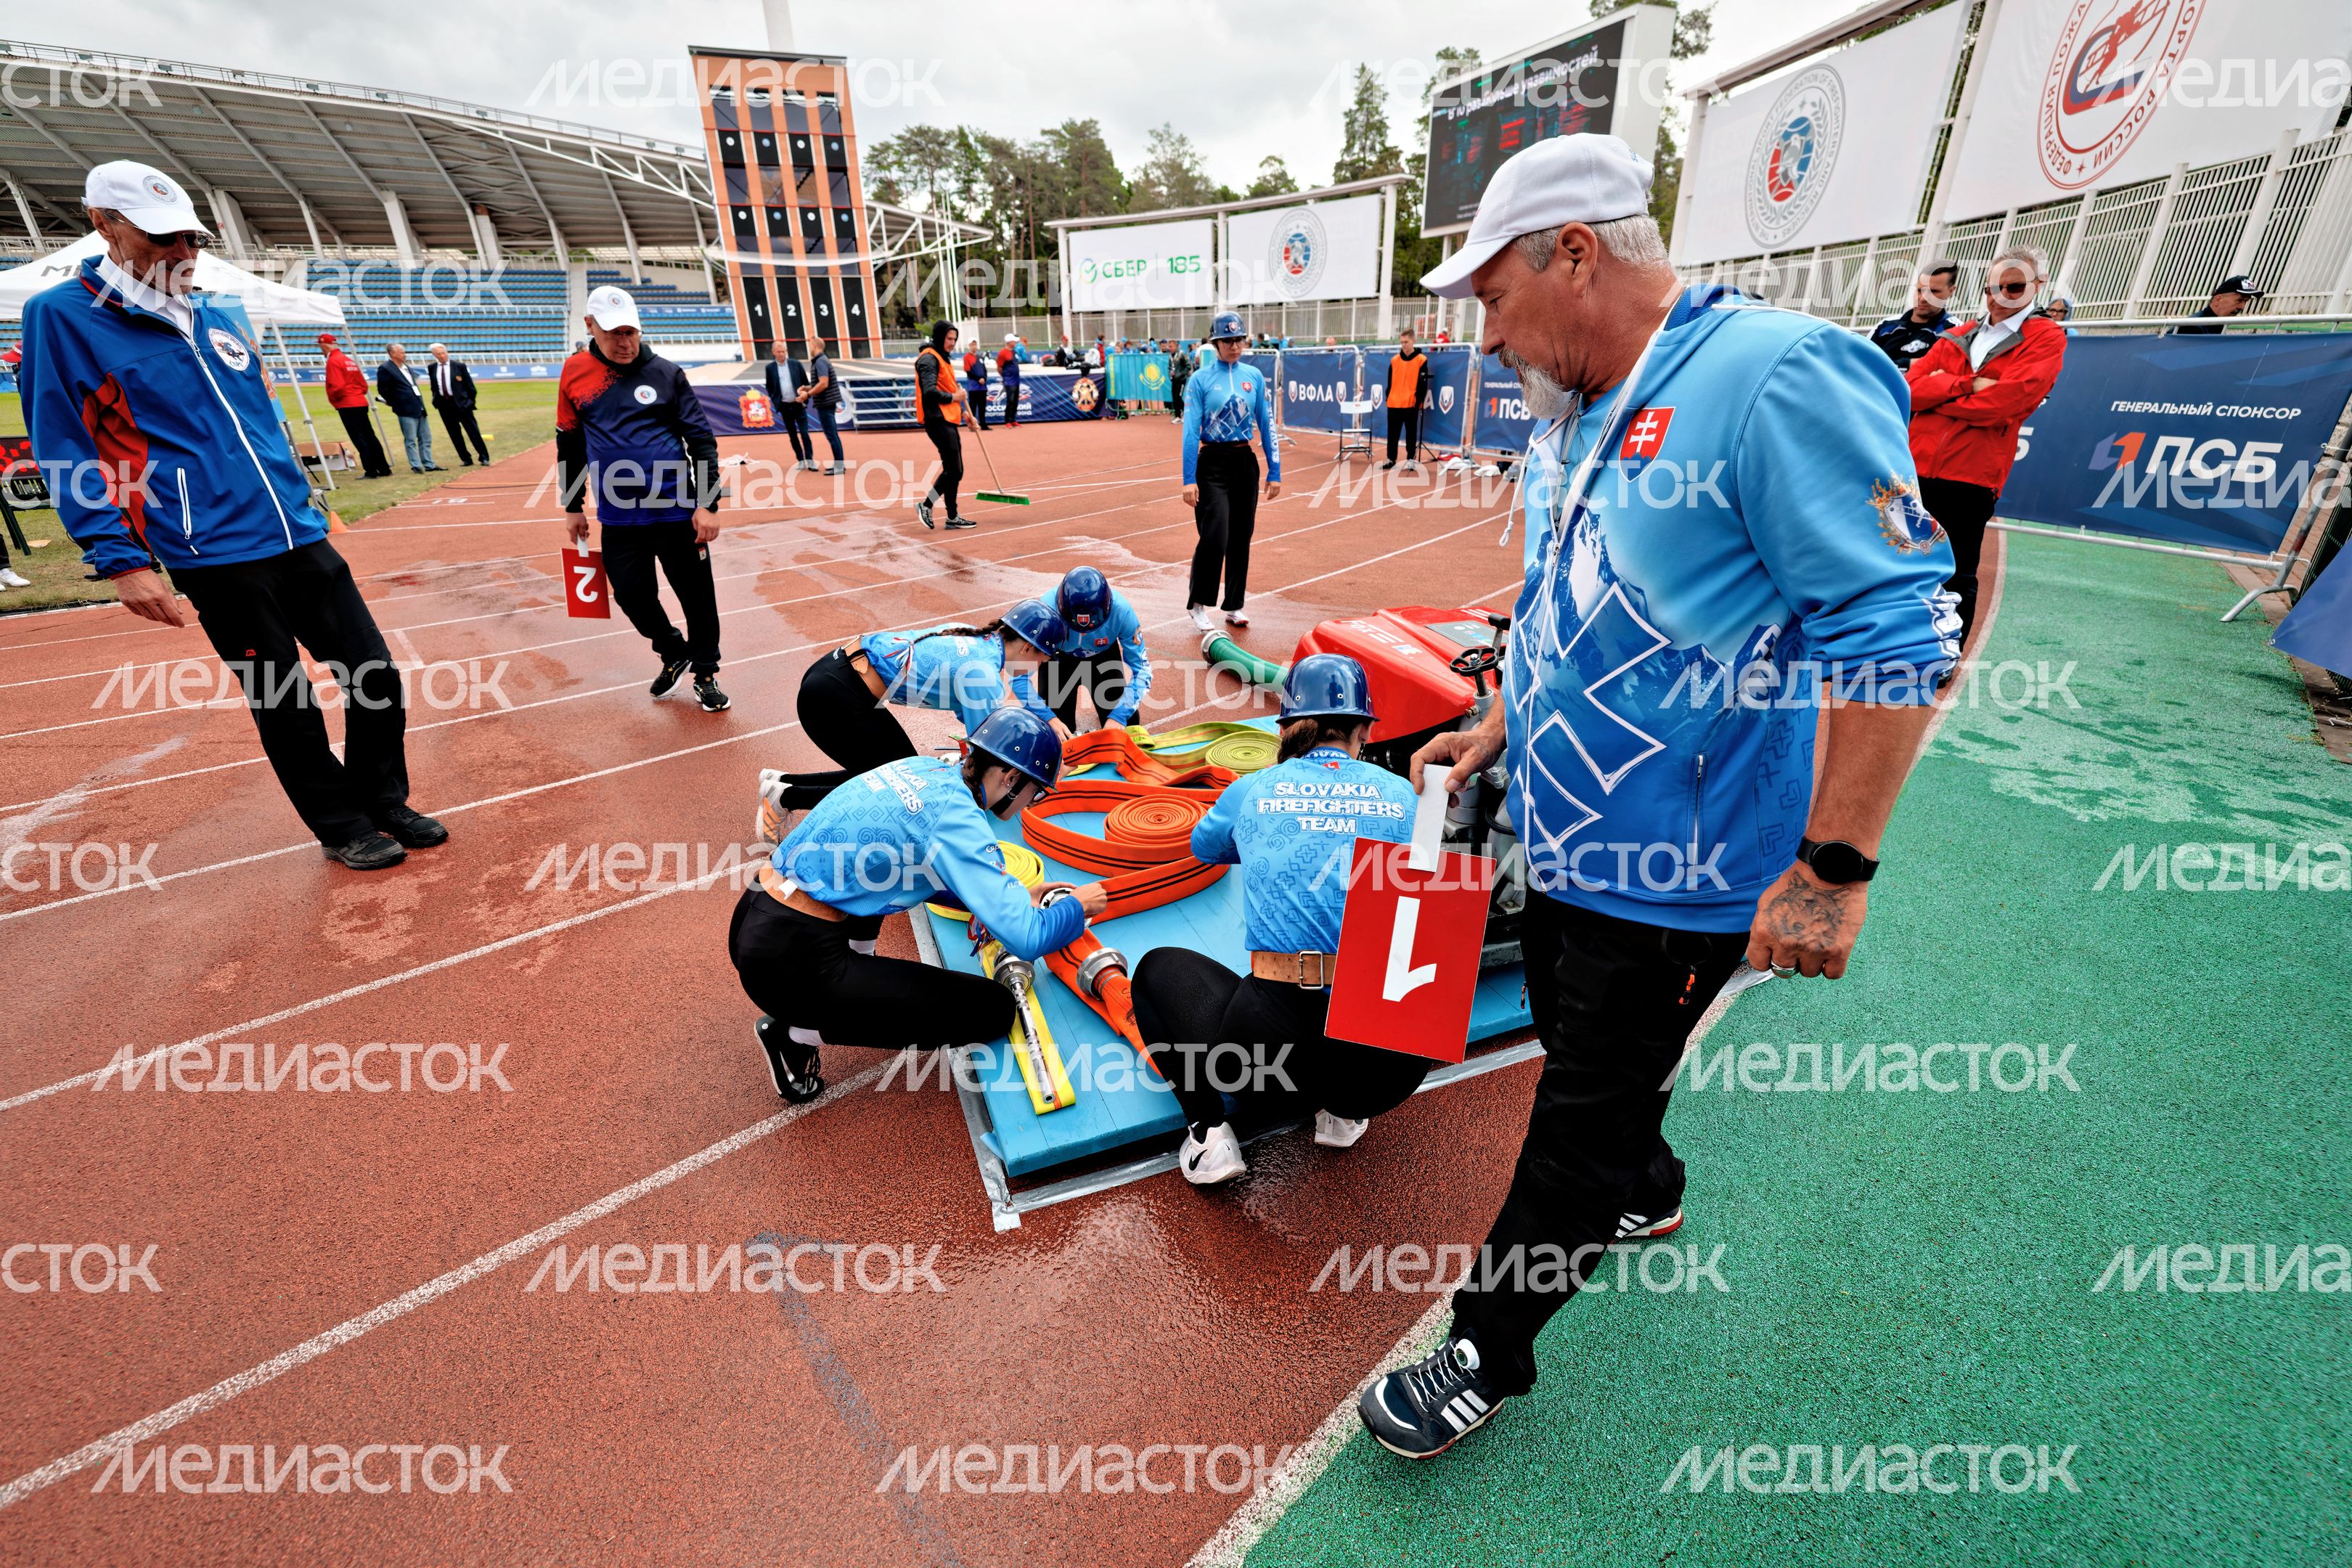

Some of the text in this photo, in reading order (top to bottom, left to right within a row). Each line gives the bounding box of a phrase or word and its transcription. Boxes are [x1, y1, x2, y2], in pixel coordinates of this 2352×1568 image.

[2044, 85, 2072, 175] ФЕДЕРАЦИЯ
[2094, 89, 2156, 168] РОССИИ
[1817, 161, 1833, 187] AND
[1102, 256, 1201, 278] СБЕР 185
[754, 304, 762, 317] 1
[786, 304, 796, 317] 2
[819, 303, 829, 317] 3
[851, 303, 860, 316] 4
[1298, 383, 1334, 402] ВФЛА
[2110, 399, 2302, 420] ГЕНЕРАЛЬНЫЙ СПОНСОР
[2145, 436, 2284, 483] ПСБ
[573, 565, 598, 603] 2
[1274, 783, 1383, 799] SLOVAKIA
[1257, 799, 1405, 821] FIREFIGHTERS
[1297, 816, 1357, 834] TEAM
[1382, 895, 1437, 1003] 1
